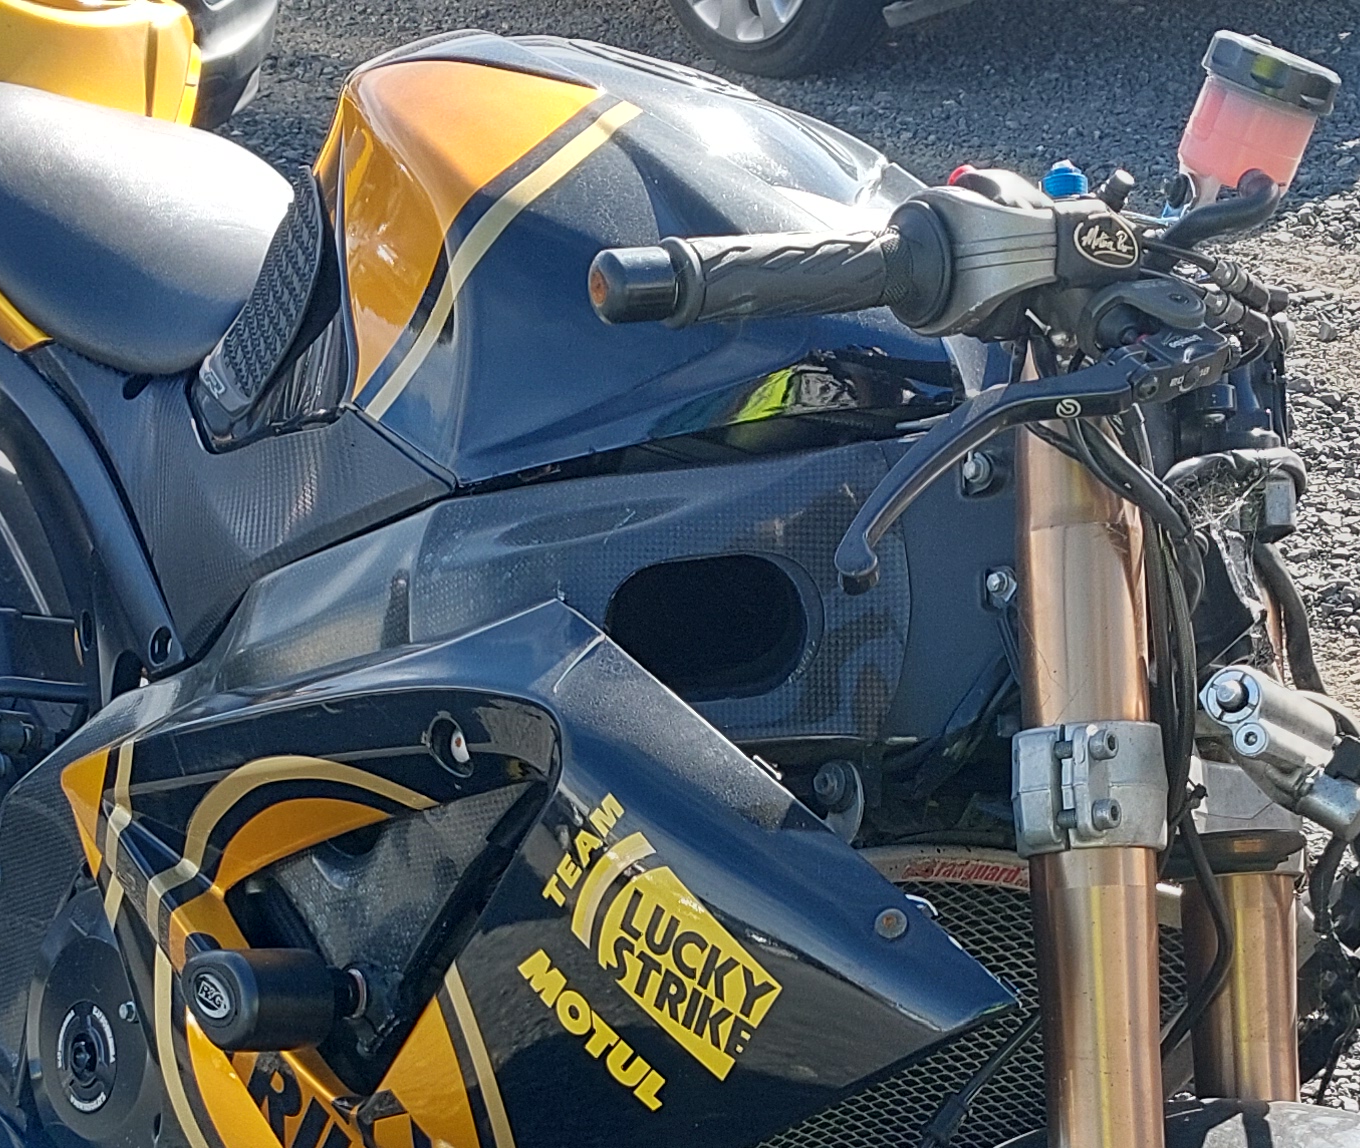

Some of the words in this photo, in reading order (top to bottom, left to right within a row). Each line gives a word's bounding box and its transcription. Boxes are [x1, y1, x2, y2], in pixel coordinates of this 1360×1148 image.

[542, 793, 625, 907] TEAM
[606, 936, 752, 1056] STRIKE
[619, 887, 775, 1017] LUCKY
[517, 949, 667, 1112] MOTUL
